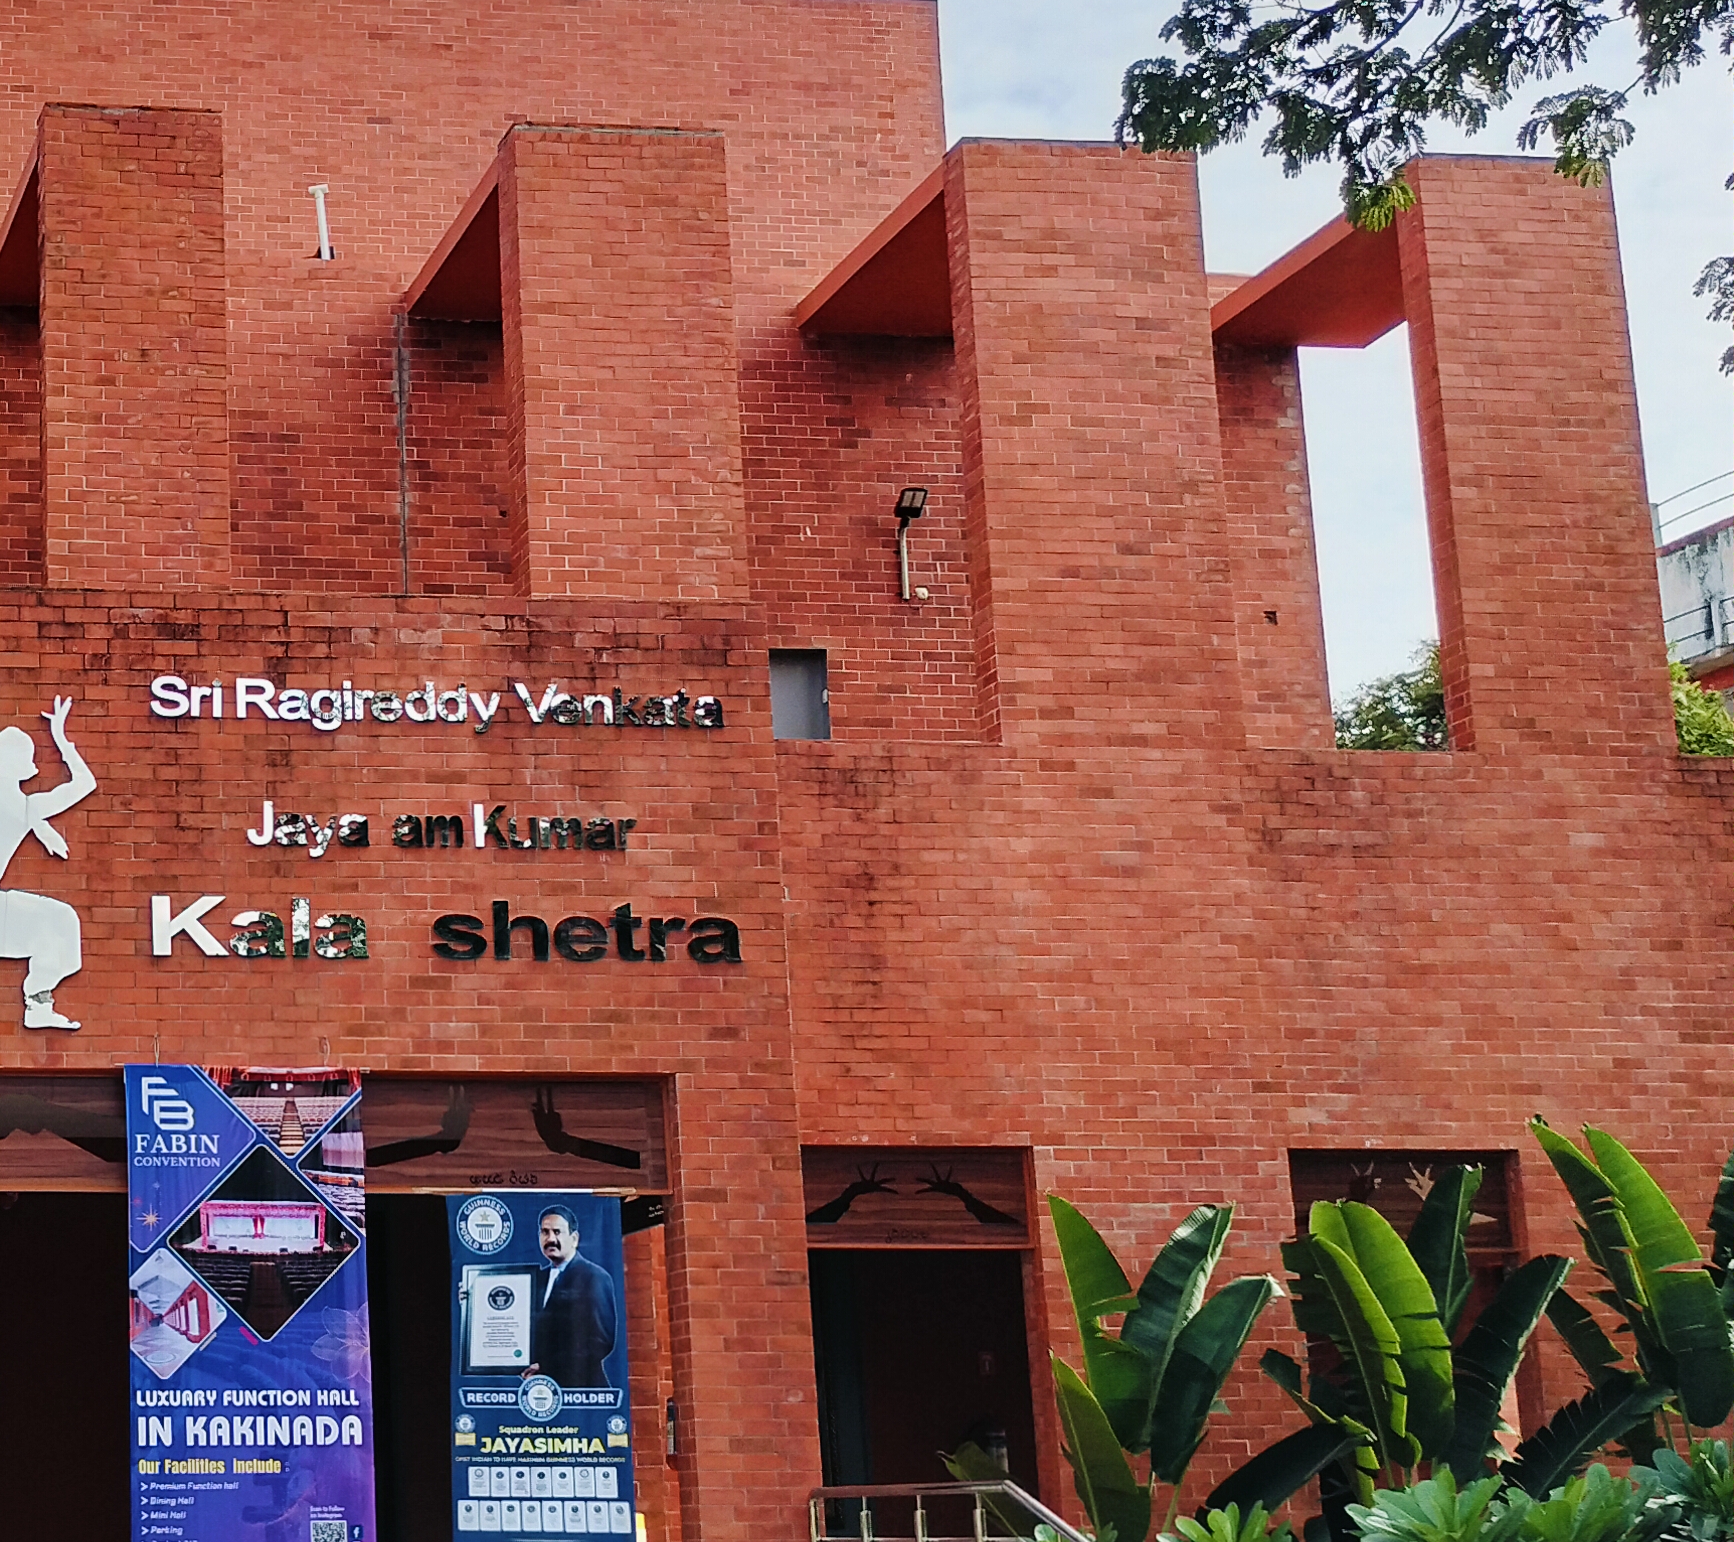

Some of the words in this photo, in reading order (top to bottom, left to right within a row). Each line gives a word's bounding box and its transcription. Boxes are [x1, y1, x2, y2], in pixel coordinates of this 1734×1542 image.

[149, 675, 223, 719] Sri
[236, 677, 500, 734] Ragireddy
[515, 681, 725, 730] Venkata
[247, 800, 370, 858] Jaya
[473, 803, 637, 850] Kumar
[149, 894, 369, 960] Kala
[432, 899, 743, 965] shetra
[134, 1134, 221, 1154] FABIN
[133, 1156, 222, 1168] CONVENTION
[463, 1199, 506, 1217] GUINNESS
[458, 1220, 481, 1250] WORLD
[481, 1220, 512, 1252] RECORDS
[136, 1389, 217, 1407] LUXUARY
[223, 1389, 311, 1406] FUNCTION
[317, 1389, 360, 1406] HALL
[467, 1393, 516, 1403] RECORD
[564, 1393, 615, 1404] HOLDER
[137, 1415, 173, 1447] IN
[185, 1414, 364, 1447] KAKINADA
[499, 1425, 545, 1436] Squadron
[546, 1425, 579, 1434] Leader
[480, 1437, 606, 1454] JAYASIMHA
[138, 1459, 161, 1474] Our
[164, 1458, 226, 1474] Facilities
[233, 1457, 282, 1473] Include
[149, 1482, 186, 1491] Premium
[187, 1482, 223, 1491] Function
[224, 1481, 239, 1490] hall
[149, 1496, 177, 1507] Dining
[178, 1496, 195, 1505] Hall
[150, 1511, 168, 1519] Mini
[170, 1511, 187, 1519] Hall
[150, 1526, 183, 1536] Parking
